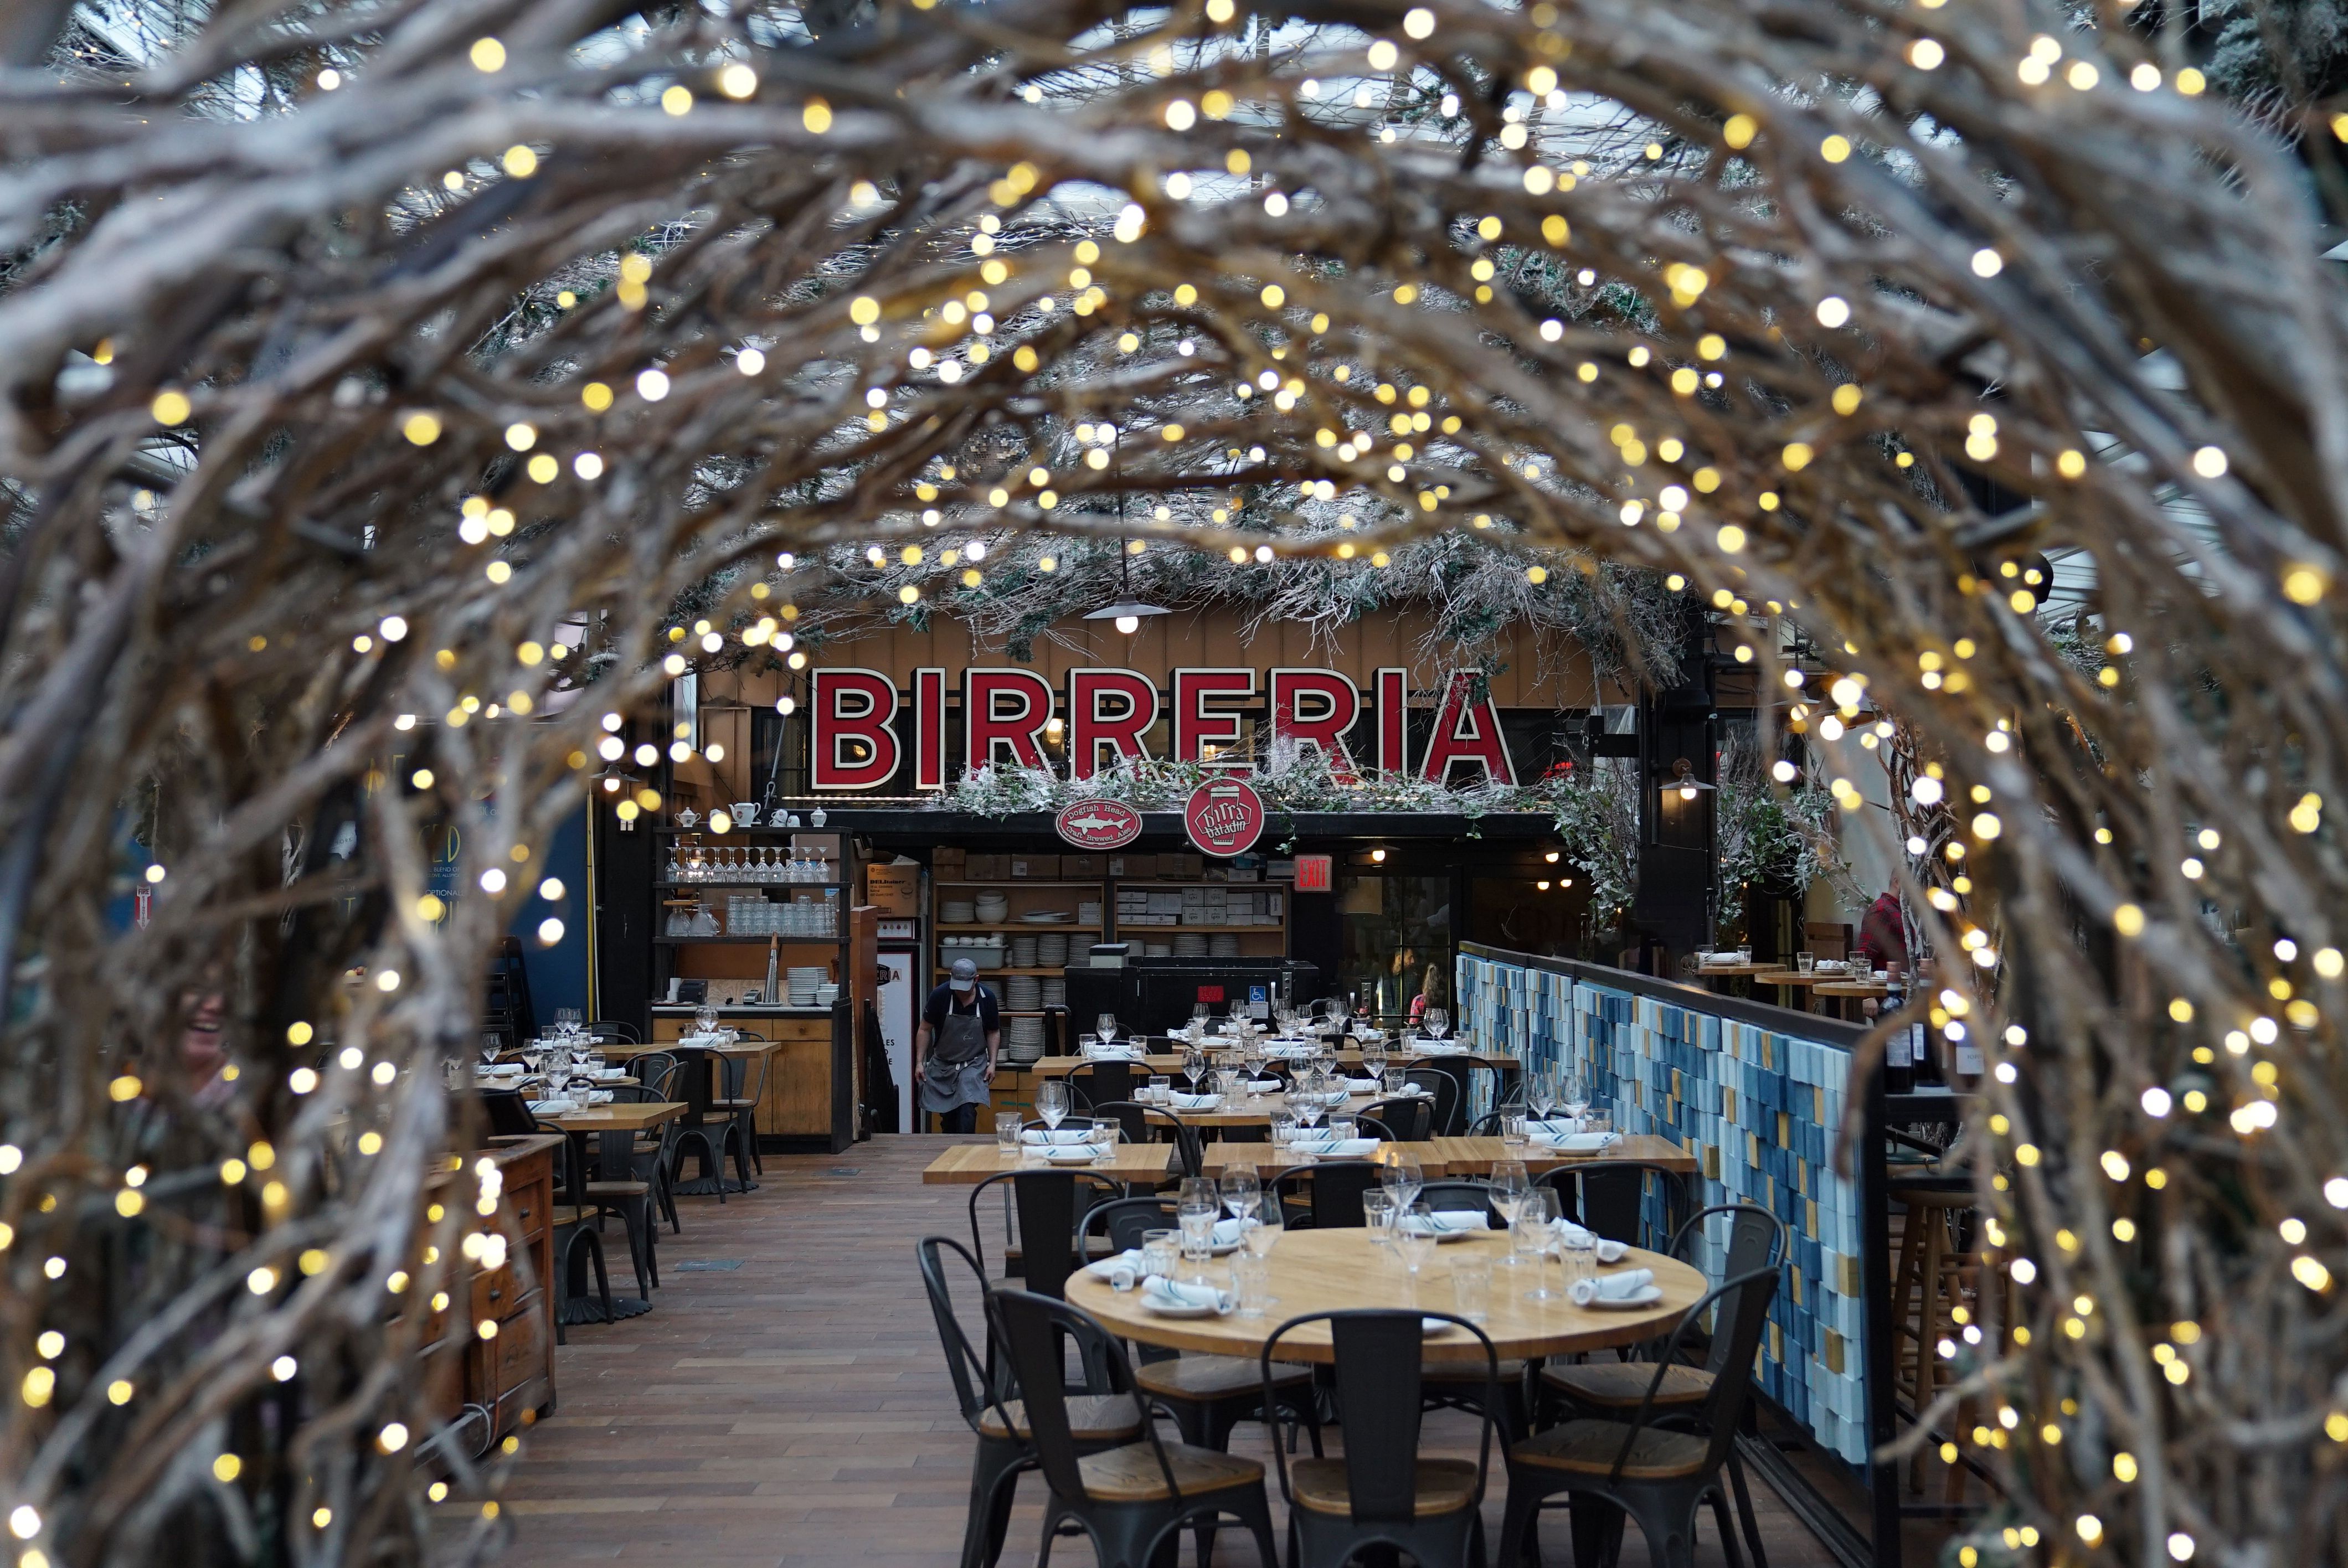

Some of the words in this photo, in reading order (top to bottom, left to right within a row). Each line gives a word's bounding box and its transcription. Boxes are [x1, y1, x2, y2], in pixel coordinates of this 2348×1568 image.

[808, 667, 1520, 790] BIRRERIA
[1067, 804, 1099, 819] Dogfish
[1104, 805, 1126, 817] Head
[1203, 802, 1245, 828] birra
[1066, 826, 1083, 839] Craft
[1086, 834, 1114, 842] Brewed
[1117, 827, 1131, 838] Ales
[1204, 819, 1247, 839] baladin
[1300, 859, 1327, 887] EXIT
